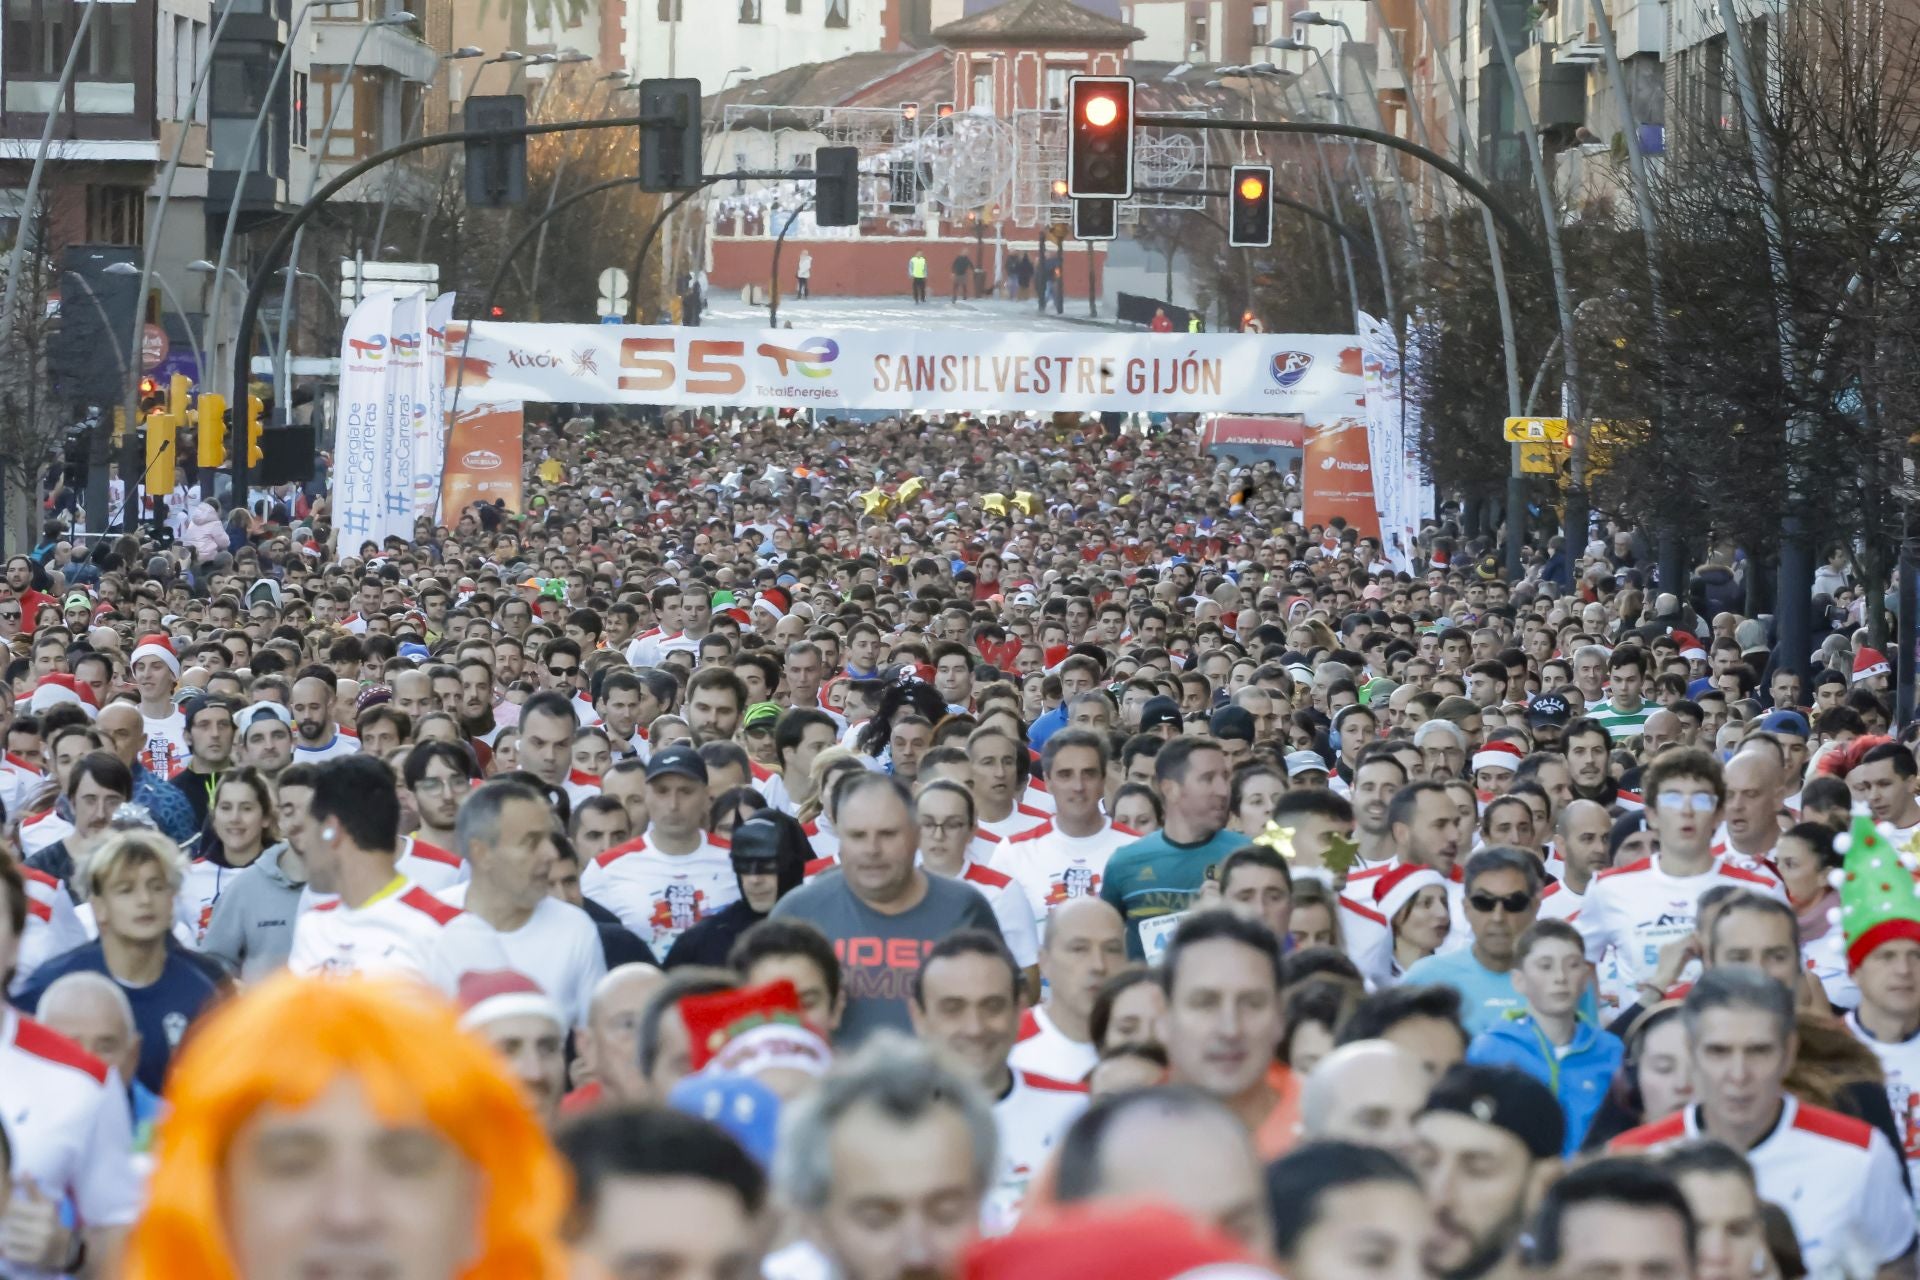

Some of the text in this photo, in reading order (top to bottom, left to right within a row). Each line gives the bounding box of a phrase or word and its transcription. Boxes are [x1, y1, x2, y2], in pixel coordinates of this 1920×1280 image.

[618, 337, 746, 395] 55
[1126, 350, 1222, 395] GIJÓN
[756, 385, 839, 399] TotalEnergies
[358, 402, 377, 504] LasCarreras
[395, 394, 410, 487] LasCarreras
[1336, 460, 1369, 472] Unicaja
[1533, 697, 1565, 711] ITALIA
